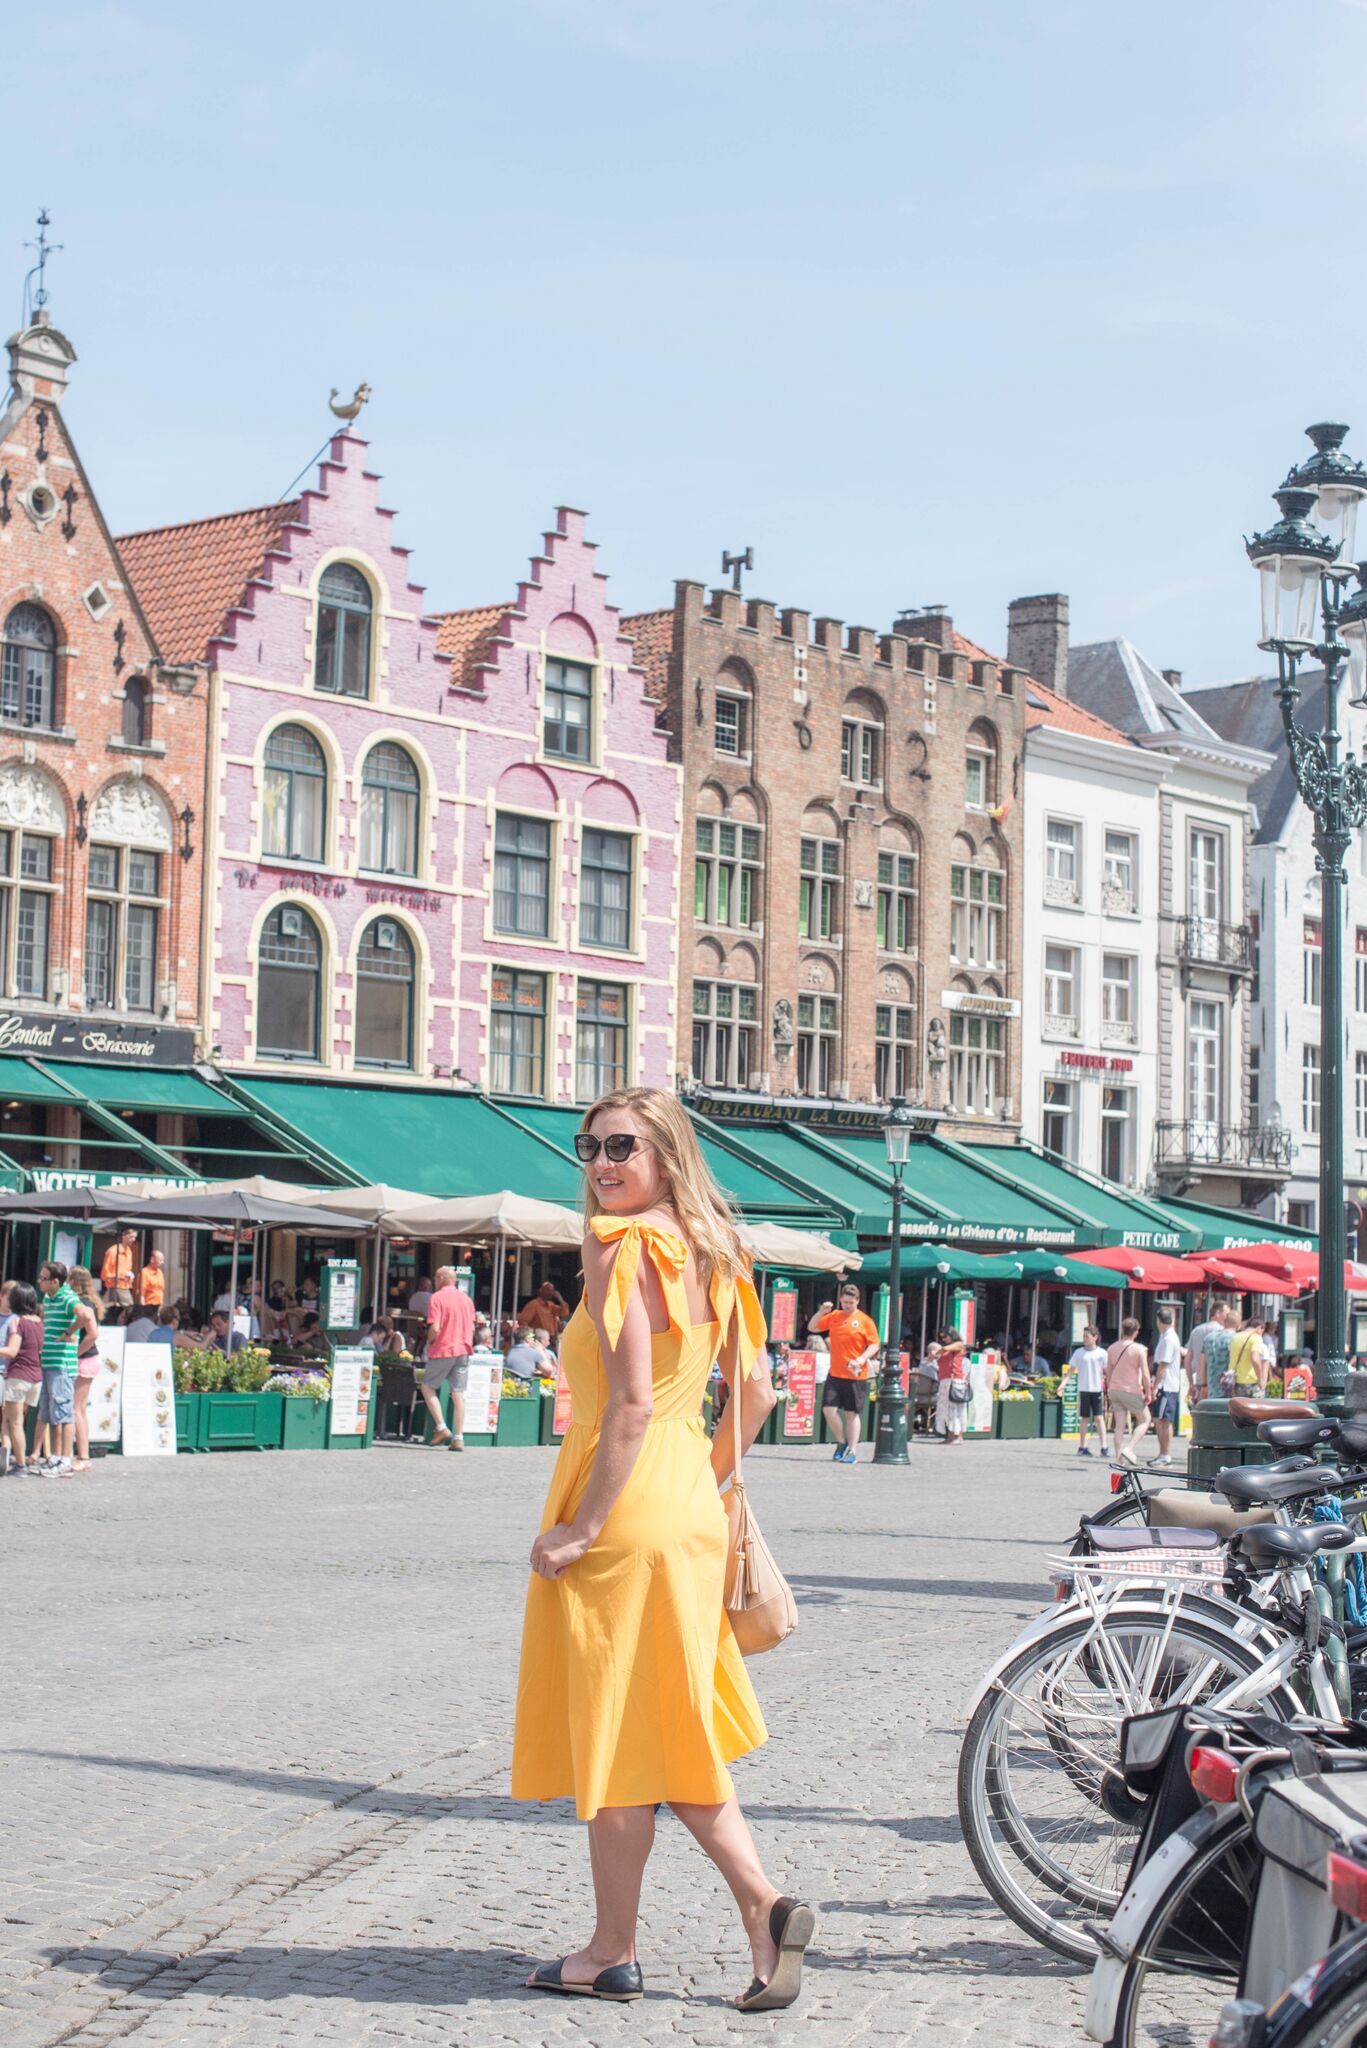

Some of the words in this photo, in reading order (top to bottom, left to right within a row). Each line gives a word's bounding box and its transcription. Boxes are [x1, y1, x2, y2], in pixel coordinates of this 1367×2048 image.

[0, 1014, 56, 1048] Central
[82, 1032, 156, 1056] Brasserie
[701, 1100, 801, 1120] RESTAURANT
[809, 1109, 829, 1122] LA
[947, 1224, 959, 1237] La
[1026, 1228, 1075, 1243] Restaurant
[1123, 1231, 1152, 1247] PETIT
